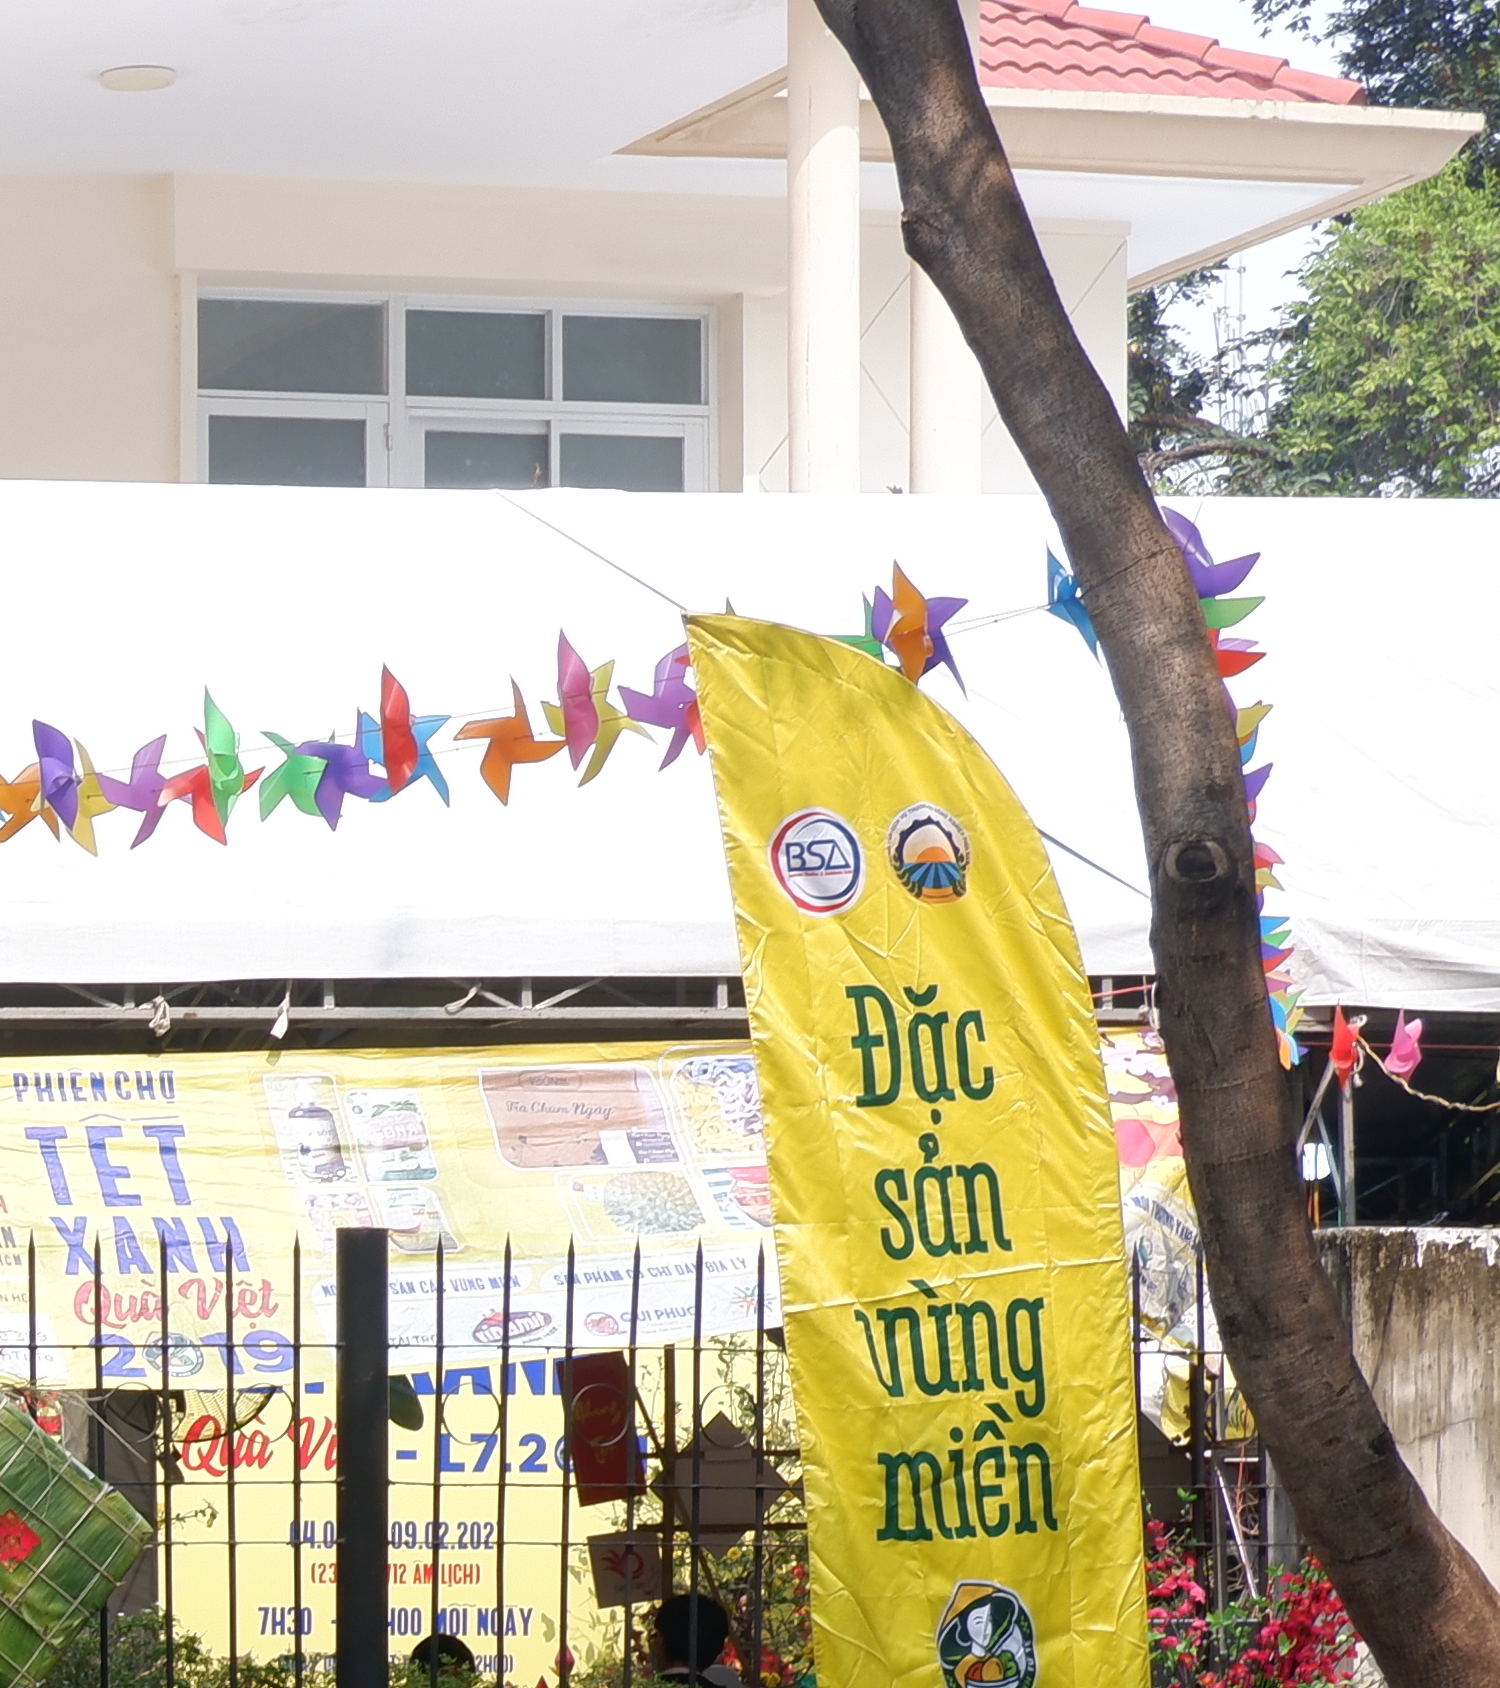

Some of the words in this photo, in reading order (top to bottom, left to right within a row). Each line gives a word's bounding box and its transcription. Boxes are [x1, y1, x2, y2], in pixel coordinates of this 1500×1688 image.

[785, 839, 852, 872] BSA
[845, 984, 994, 1125] Đặc
[13, 1068, 108, 1103] PHIÊN
[114, 1070, 176, 1104] CHỢ
[24, 1114, 192, 1206] TẾT
[874, 1132, 1012, 1260] sản
[49, 1216, 251, 1275] XANH
[178, 1277, 279, 1329] Vệt
[855, 1279, 1046, 1418] vùng
[182, 1414, 273, 1477] Quà
[876, 1404, 1059, 1541] miền
[289, 1520, 336, 1549] 04.0
[391, 1520, 499, 1550] 09.02.202
[258, 1606, 312, 1636] 7H30
